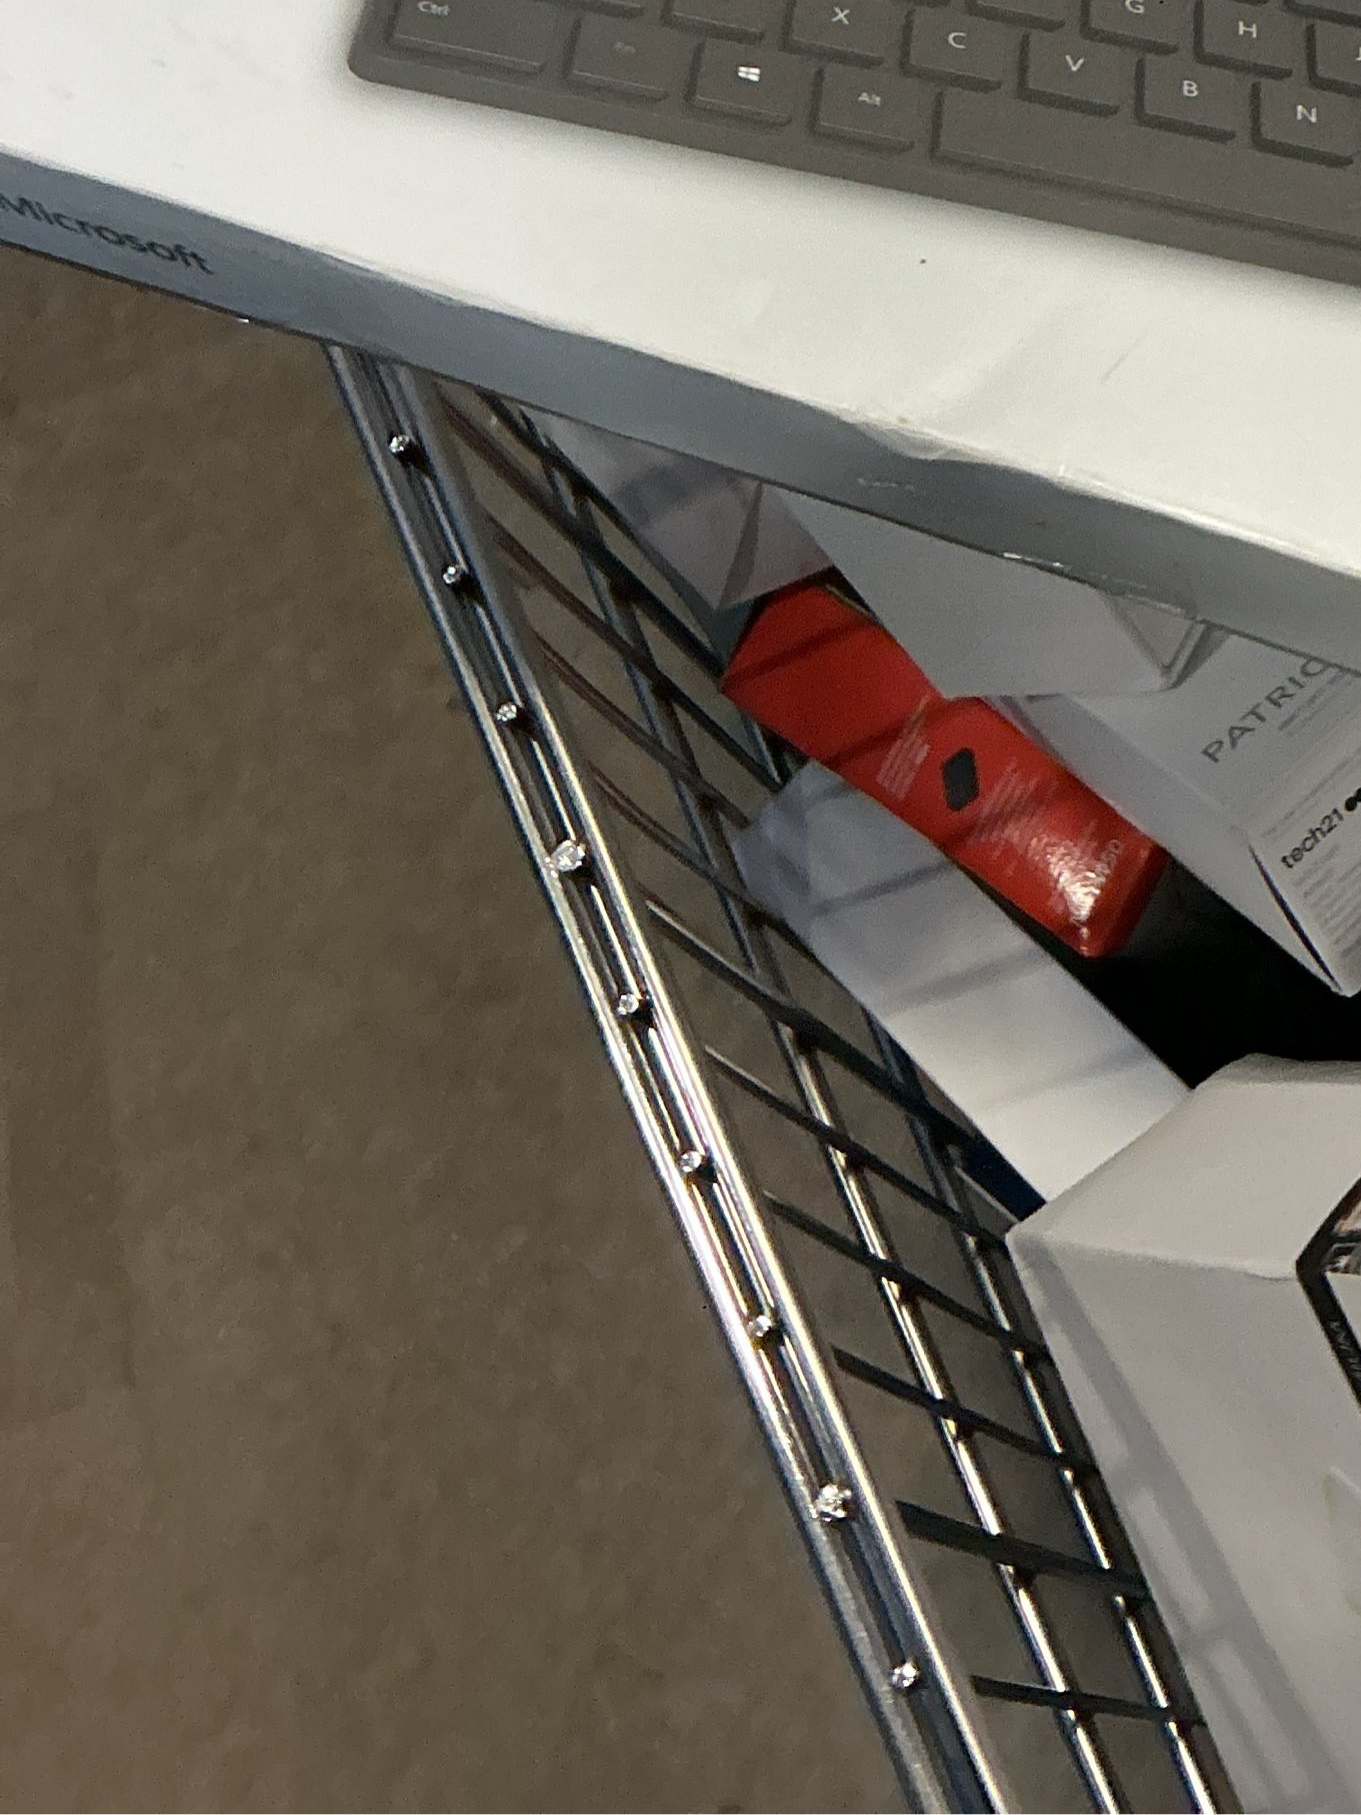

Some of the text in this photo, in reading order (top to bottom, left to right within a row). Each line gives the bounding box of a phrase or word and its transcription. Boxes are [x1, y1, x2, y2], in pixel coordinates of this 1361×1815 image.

[831, 7, 850, 25] X
[1238, 20, 1258, 39] H
[947, 31, 967, 49] C
[1065, 54, 1085, 72] V
[1182, 79, 1199, 98] B
[1296, 104, 1318, 123] N
[0, 195, 214, 275] Microsoft
[1279, 805, 1346, 870] tech21
